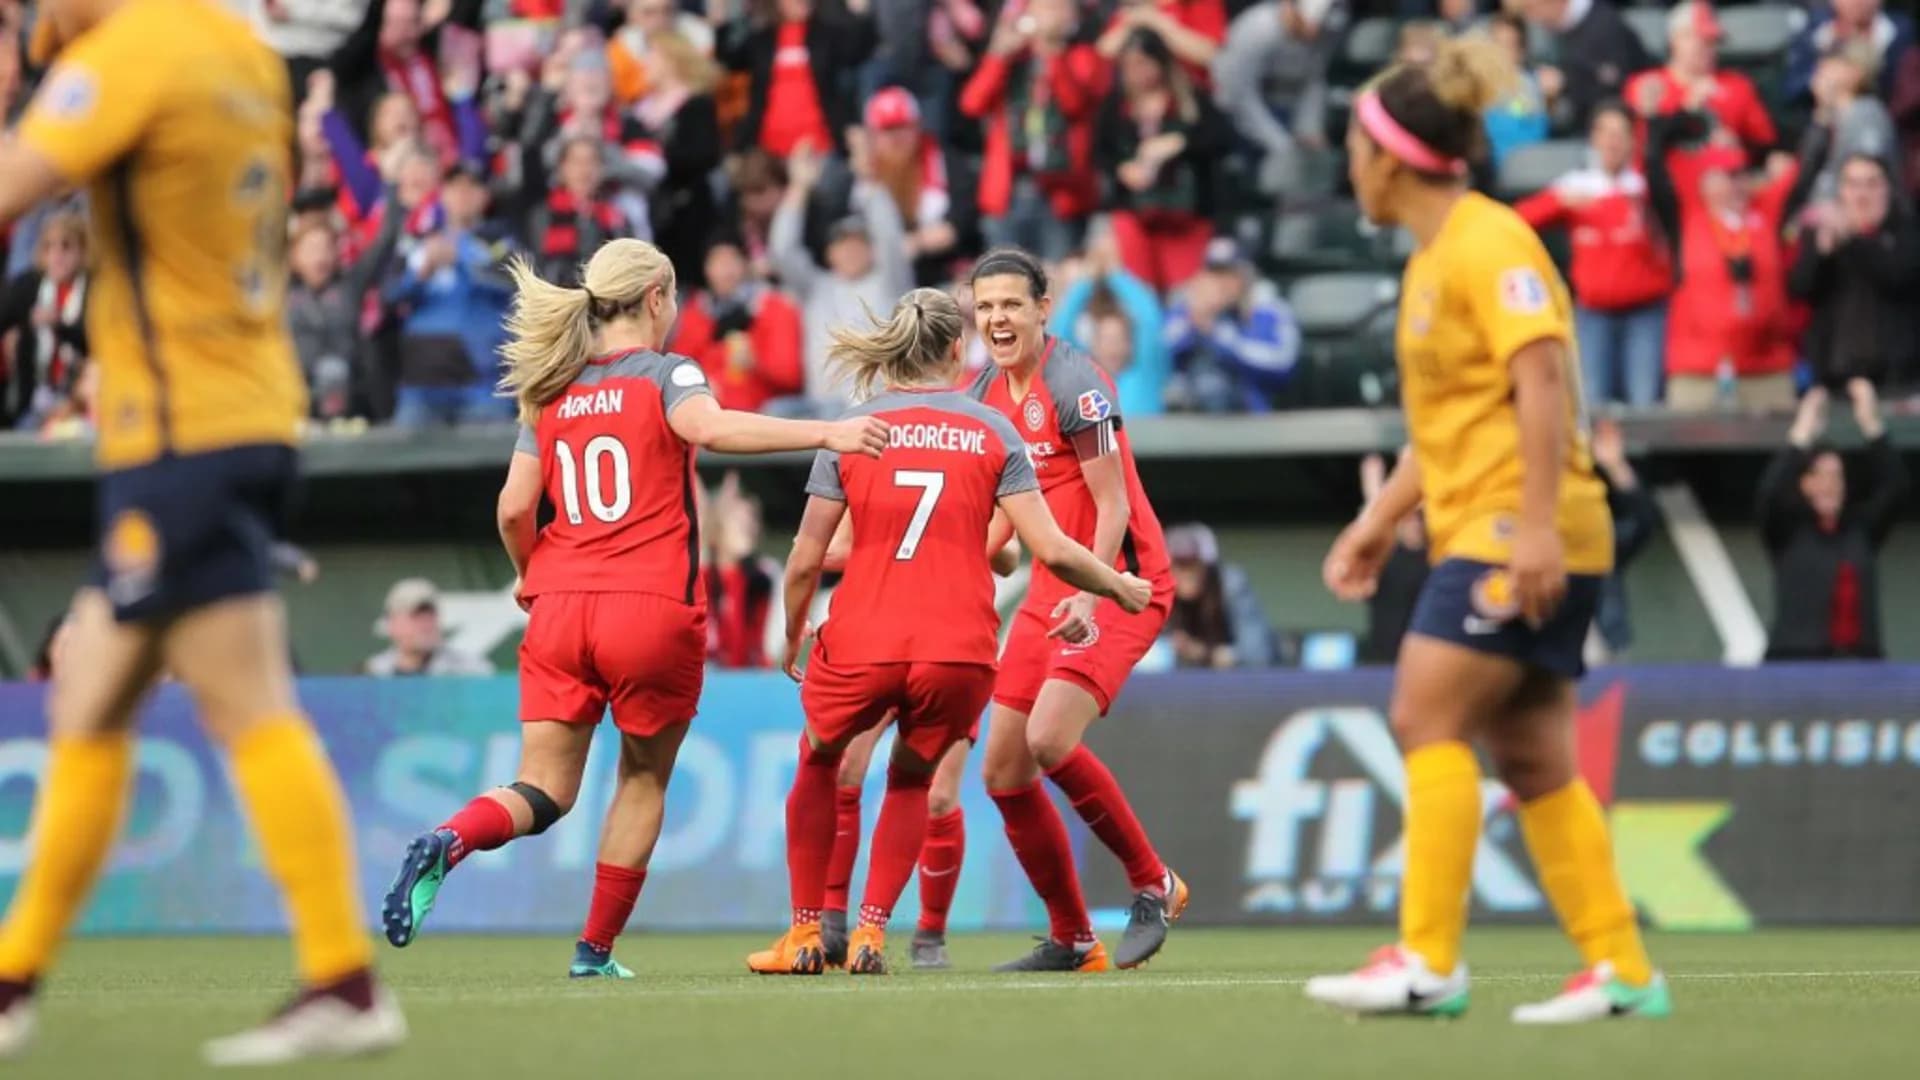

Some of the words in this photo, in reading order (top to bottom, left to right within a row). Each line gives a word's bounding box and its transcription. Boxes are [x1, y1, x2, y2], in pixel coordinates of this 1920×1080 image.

[556, 389, 623, 418] HORAN
[885, 422, 986, 455] OGORČEVIĆ
[555, 435, 631, 525] 10
[894, 470, 944, 560] 7
[1243, 880, 1401, 912] AUT
